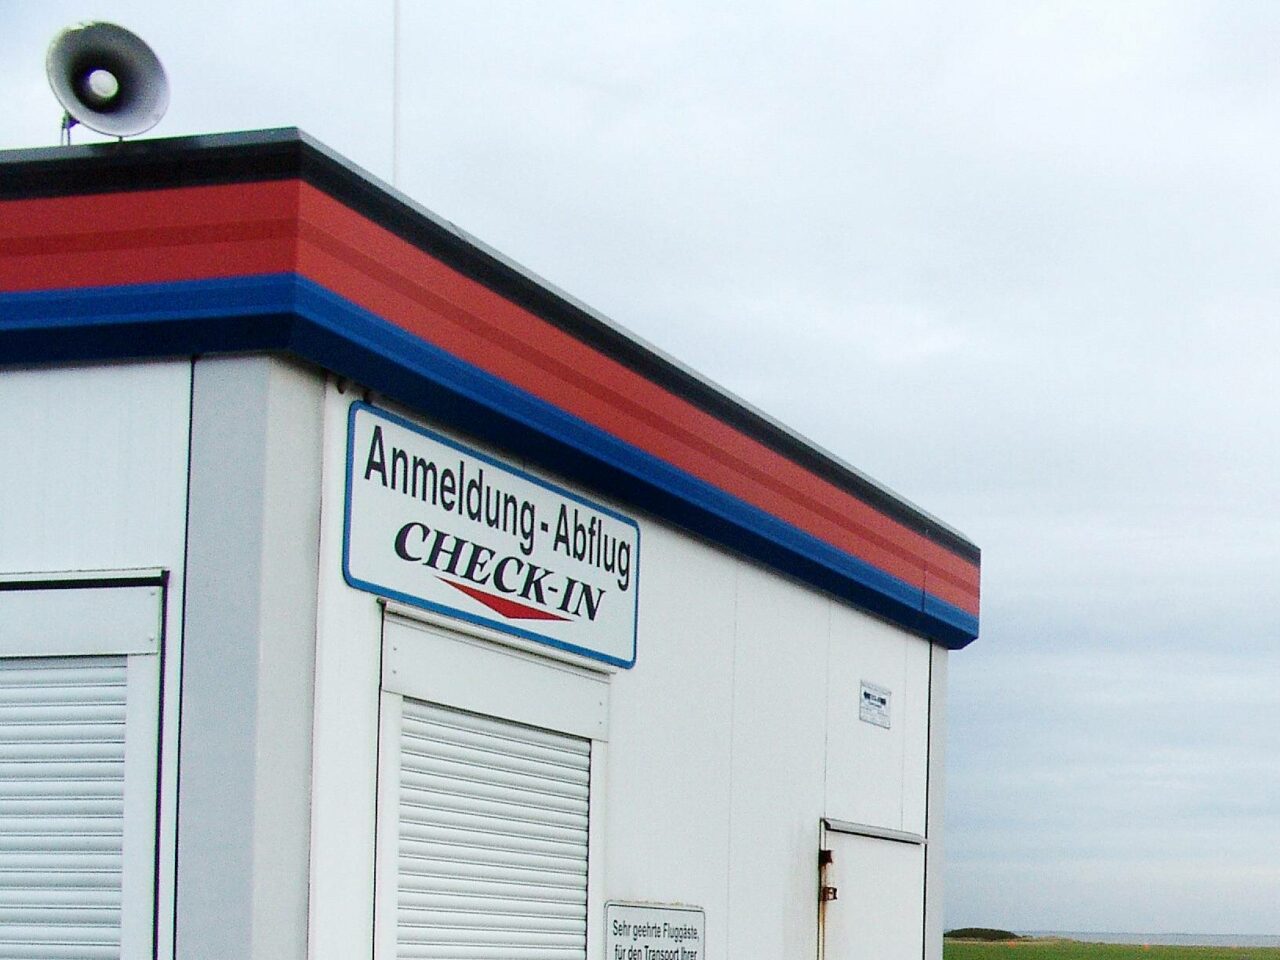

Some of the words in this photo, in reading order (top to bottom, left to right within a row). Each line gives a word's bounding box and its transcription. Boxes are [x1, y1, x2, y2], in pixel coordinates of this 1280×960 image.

[394, 522, 606, 622] CHECK-IN
[613, 919, 631, 936] Sehr
[633, 922, 661, 941] geehrte
[663, 922, 699, 942] Fluggäste,
[615, 944, 626, 960] für
[628, 945, 642, 960] den
